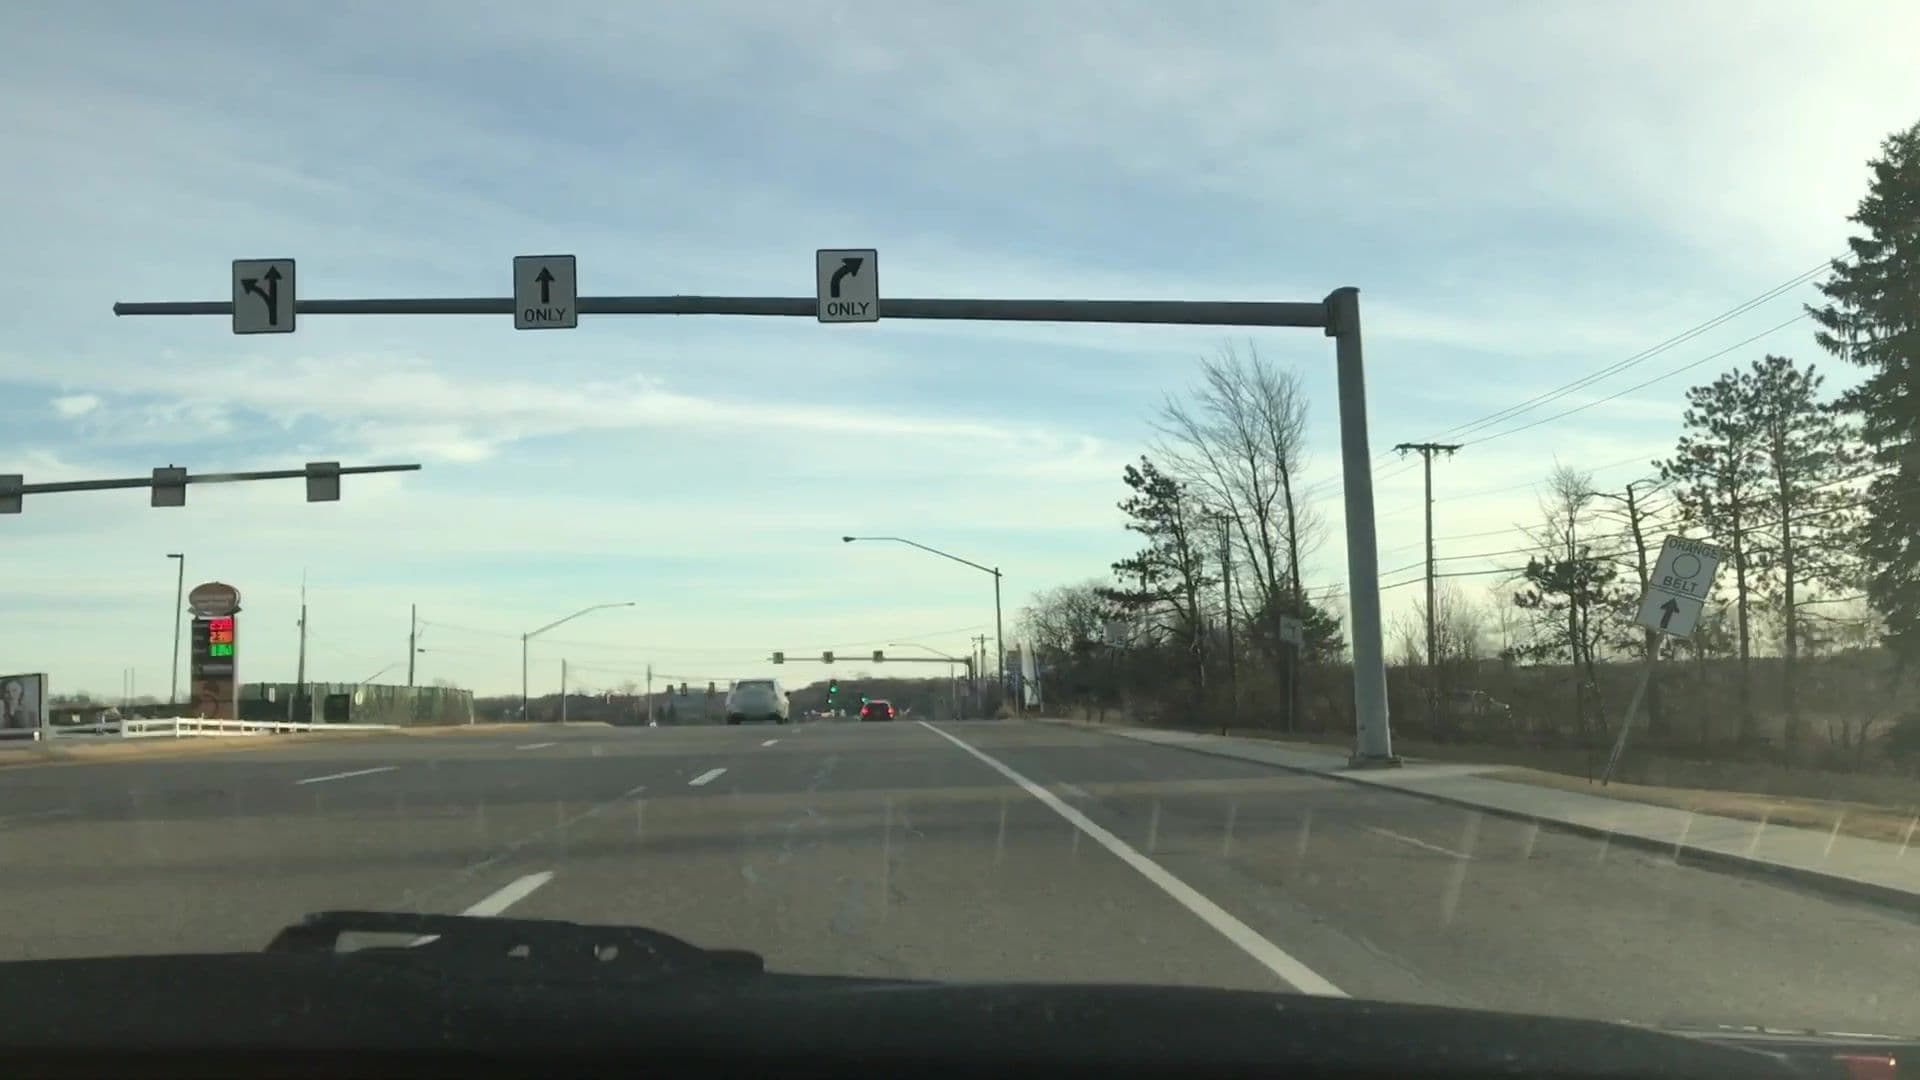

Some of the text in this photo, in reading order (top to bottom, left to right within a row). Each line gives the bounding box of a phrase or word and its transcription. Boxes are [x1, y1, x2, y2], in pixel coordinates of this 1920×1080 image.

[524, 308, 566, 322] ONLY
[827, 302, 870, 316] ONLY
[1669, 538, 1718, 560] ORANGE
[1663, 575, 1698, 593] BELT
